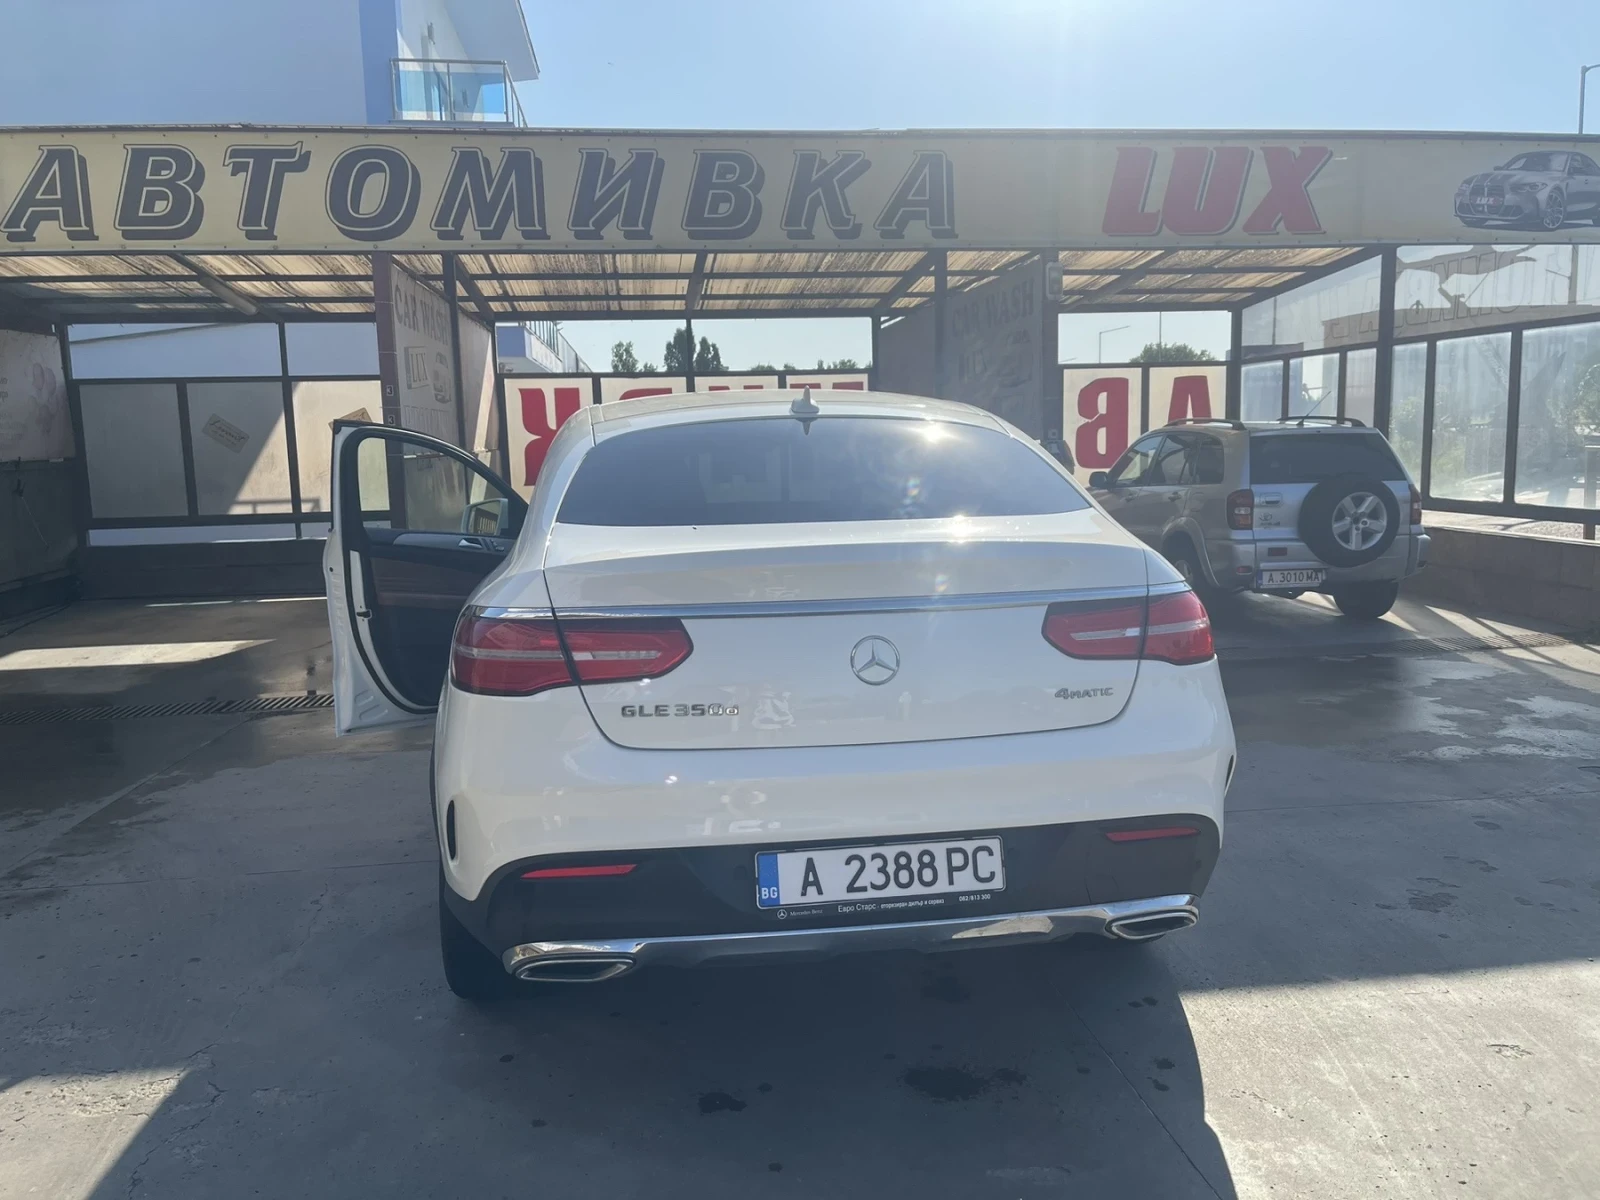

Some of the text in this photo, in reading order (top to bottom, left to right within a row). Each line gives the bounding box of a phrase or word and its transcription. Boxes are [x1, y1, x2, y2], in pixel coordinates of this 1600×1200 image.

[0, 141, 958, 242] АВТОМИВКА
[1102, 146, 1333, 236] LUX
[394, 284, 449, 346] CAR WASH
[985, 277, 1035, 328] WASH
[410, 353, 428, 383] LUX
[387, 385, 393, 395] 3
[388, 415, 395, 425] 3
[845, 849, 939, 894] 2388
[761, 887, 778, 899] BG
[856, 903, 877, 913] Старс
